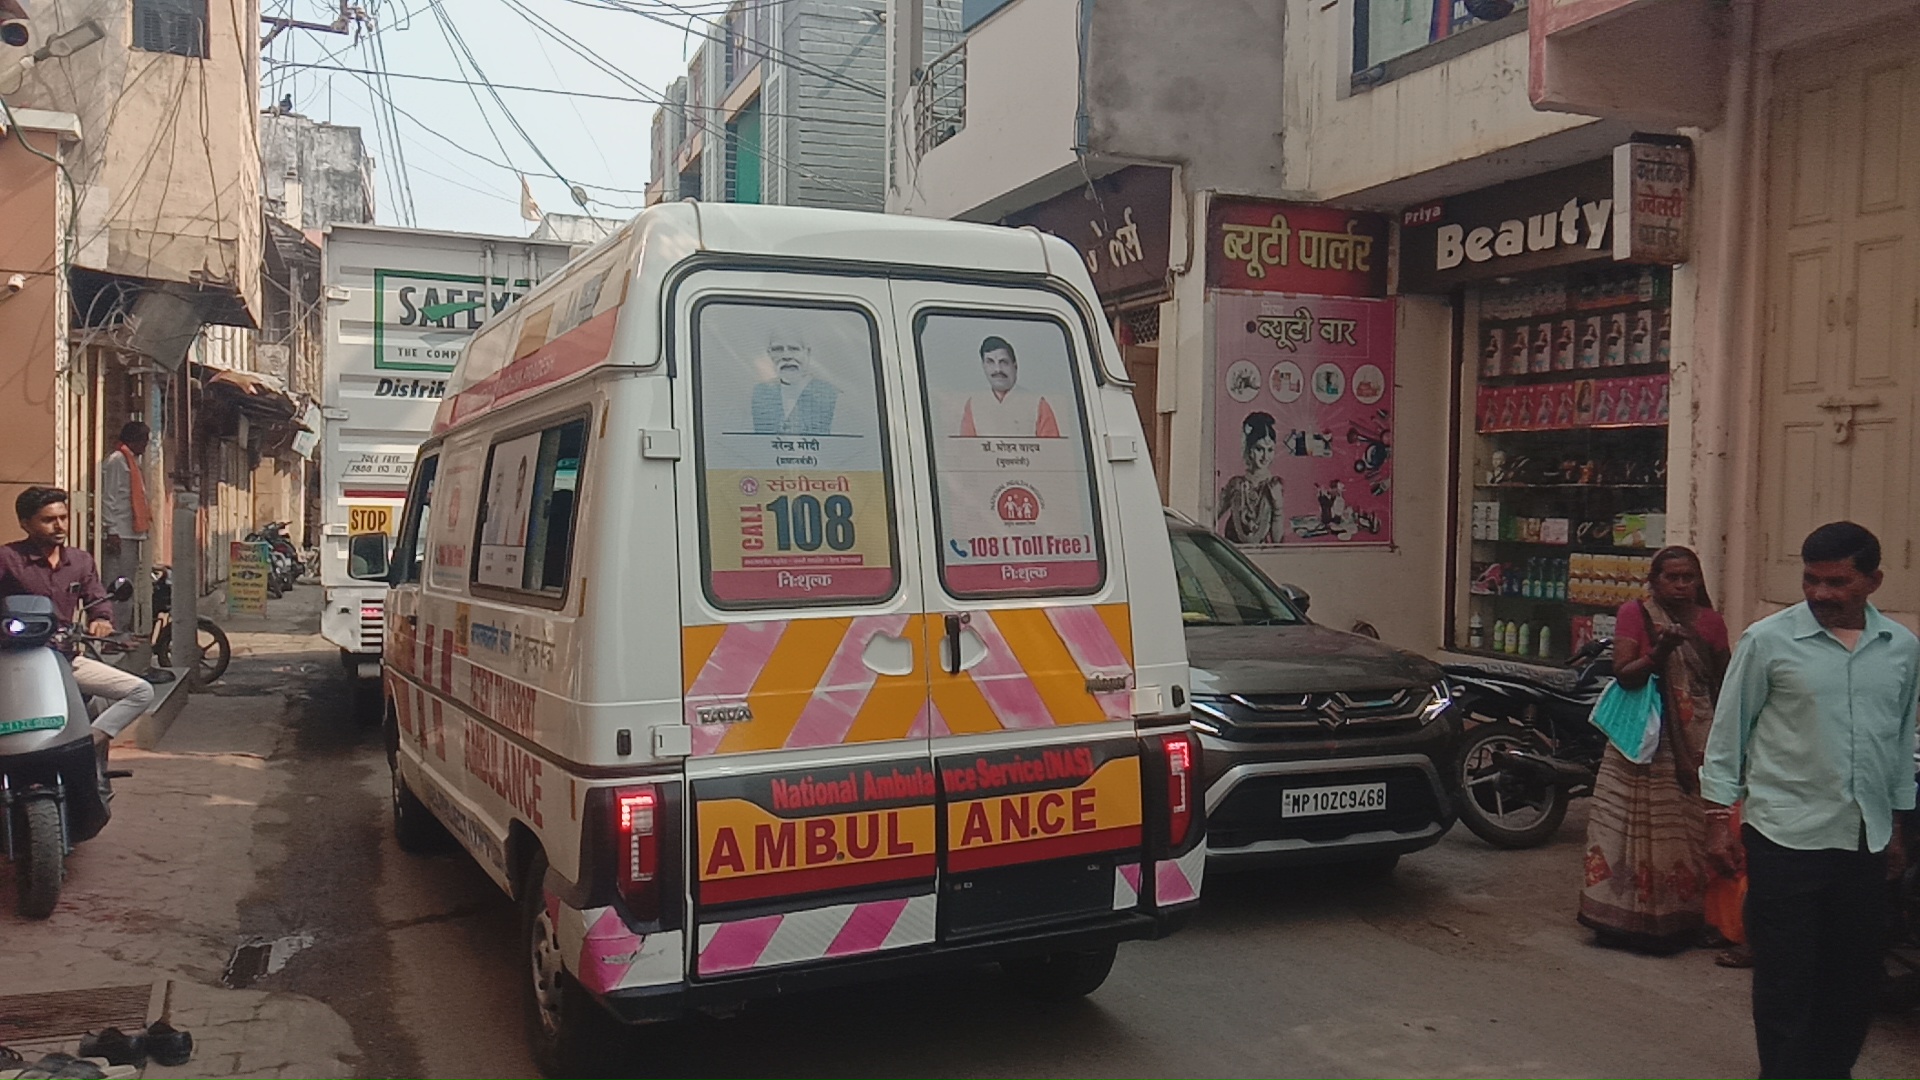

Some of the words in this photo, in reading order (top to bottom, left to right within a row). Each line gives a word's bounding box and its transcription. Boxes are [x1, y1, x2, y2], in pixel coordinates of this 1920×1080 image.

[1404, 204, 1441, 226] Priya
[1222, 213, 1291, 279] ब्यूटी
[1298, 219, 1374, 272] पार्लर
[1436, 196, 1613, 271] Beauty
[399, 285, 522, 329] SAFEX
[1257, 306, 1313, 353] ब्यूटी
[1318, 318, 1357, 346] बार
[398, 348, 417, 357] THE
[796, 437, 820, 451] मोदी
[350, 509, 387, 531] STOP
[740, 503, 765, 551] CALL
[766, 494, 856, 551] 108
[968, 537, 999, 558] 108
[777, 570, 832, 591] निःशुल्क
[1001, 564, 1048, 584] निःशुल्क
[771, 773, 858, 810] National
[1291, 788, 1385, 814] MP10ZC9468
